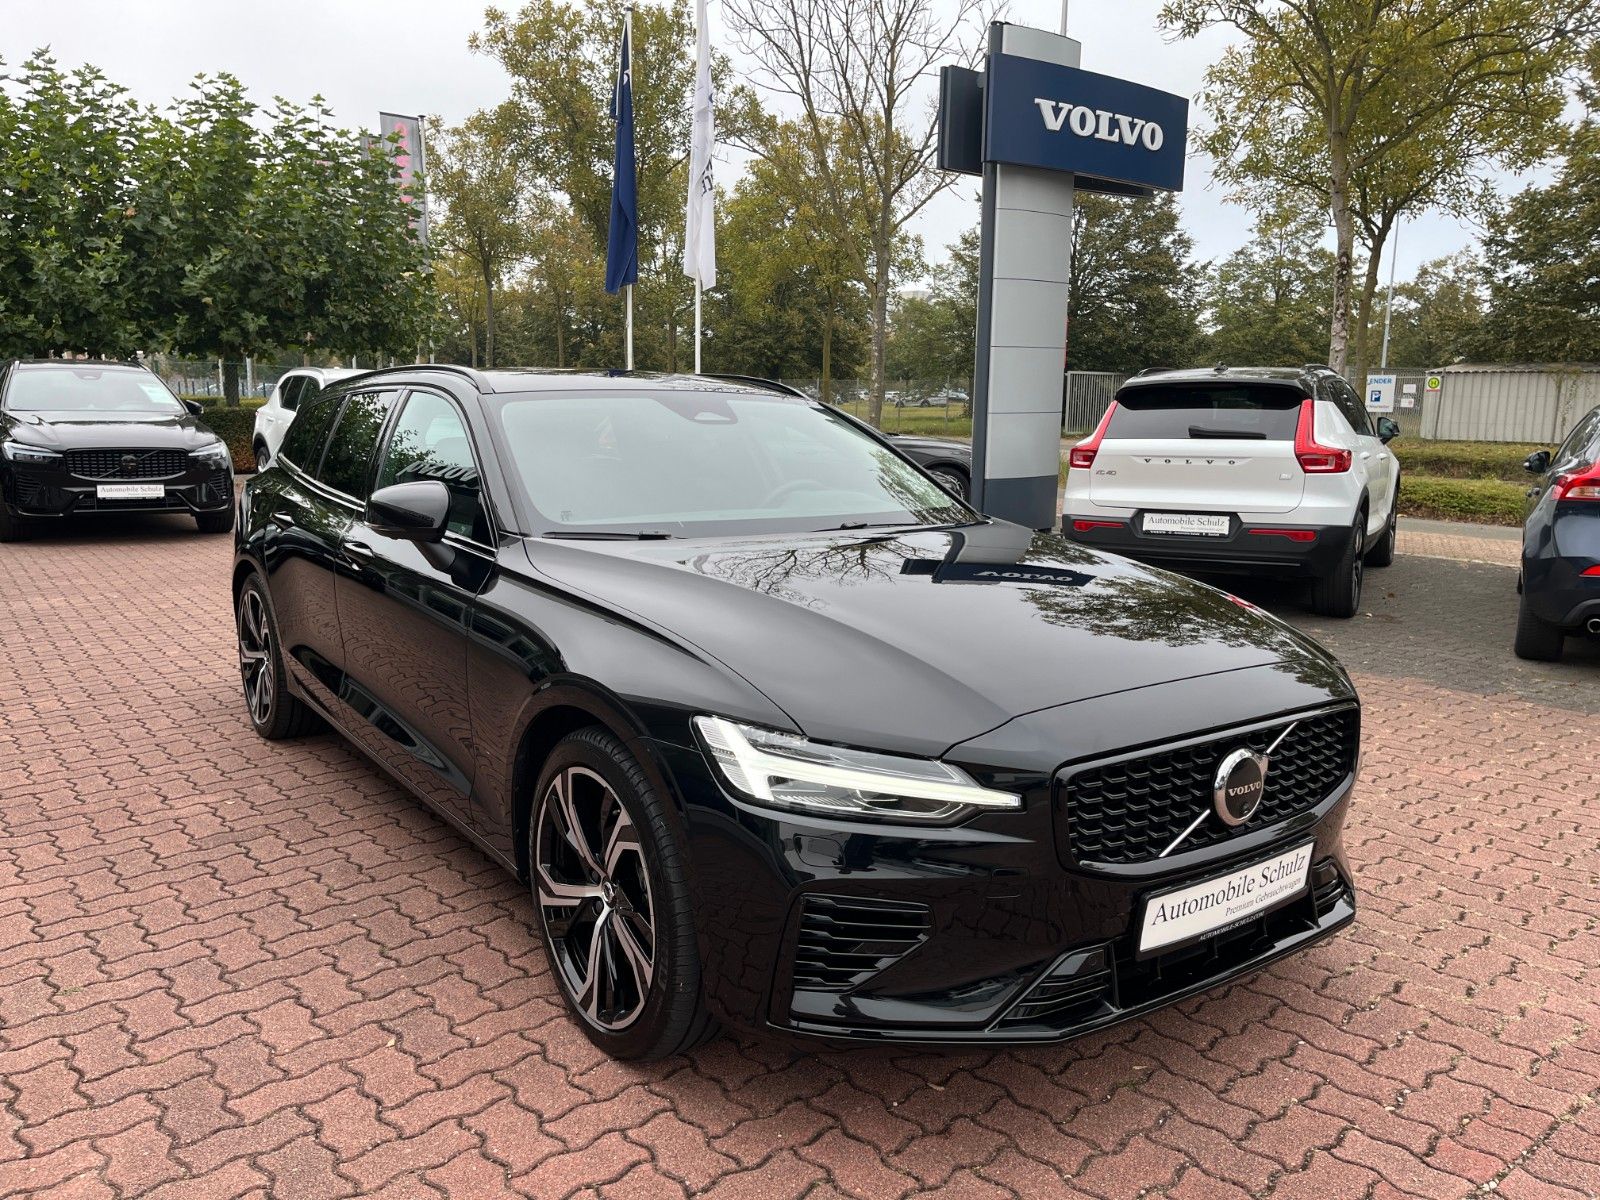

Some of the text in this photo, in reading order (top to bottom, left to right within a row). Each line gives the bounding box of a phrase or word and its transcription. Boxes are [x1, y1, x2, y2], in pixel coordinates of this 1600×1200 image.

[1034, 98, 1164, 151] VOLVO
[1148, 516, 1225, 526] Automobile Schulz
[1228, 781, 1261, 797] VOLVO
[1151, 853, 1306, 925] Automobile Schulz
[1225, 877, 1302, 917] Premium Gebrauchtwagen
